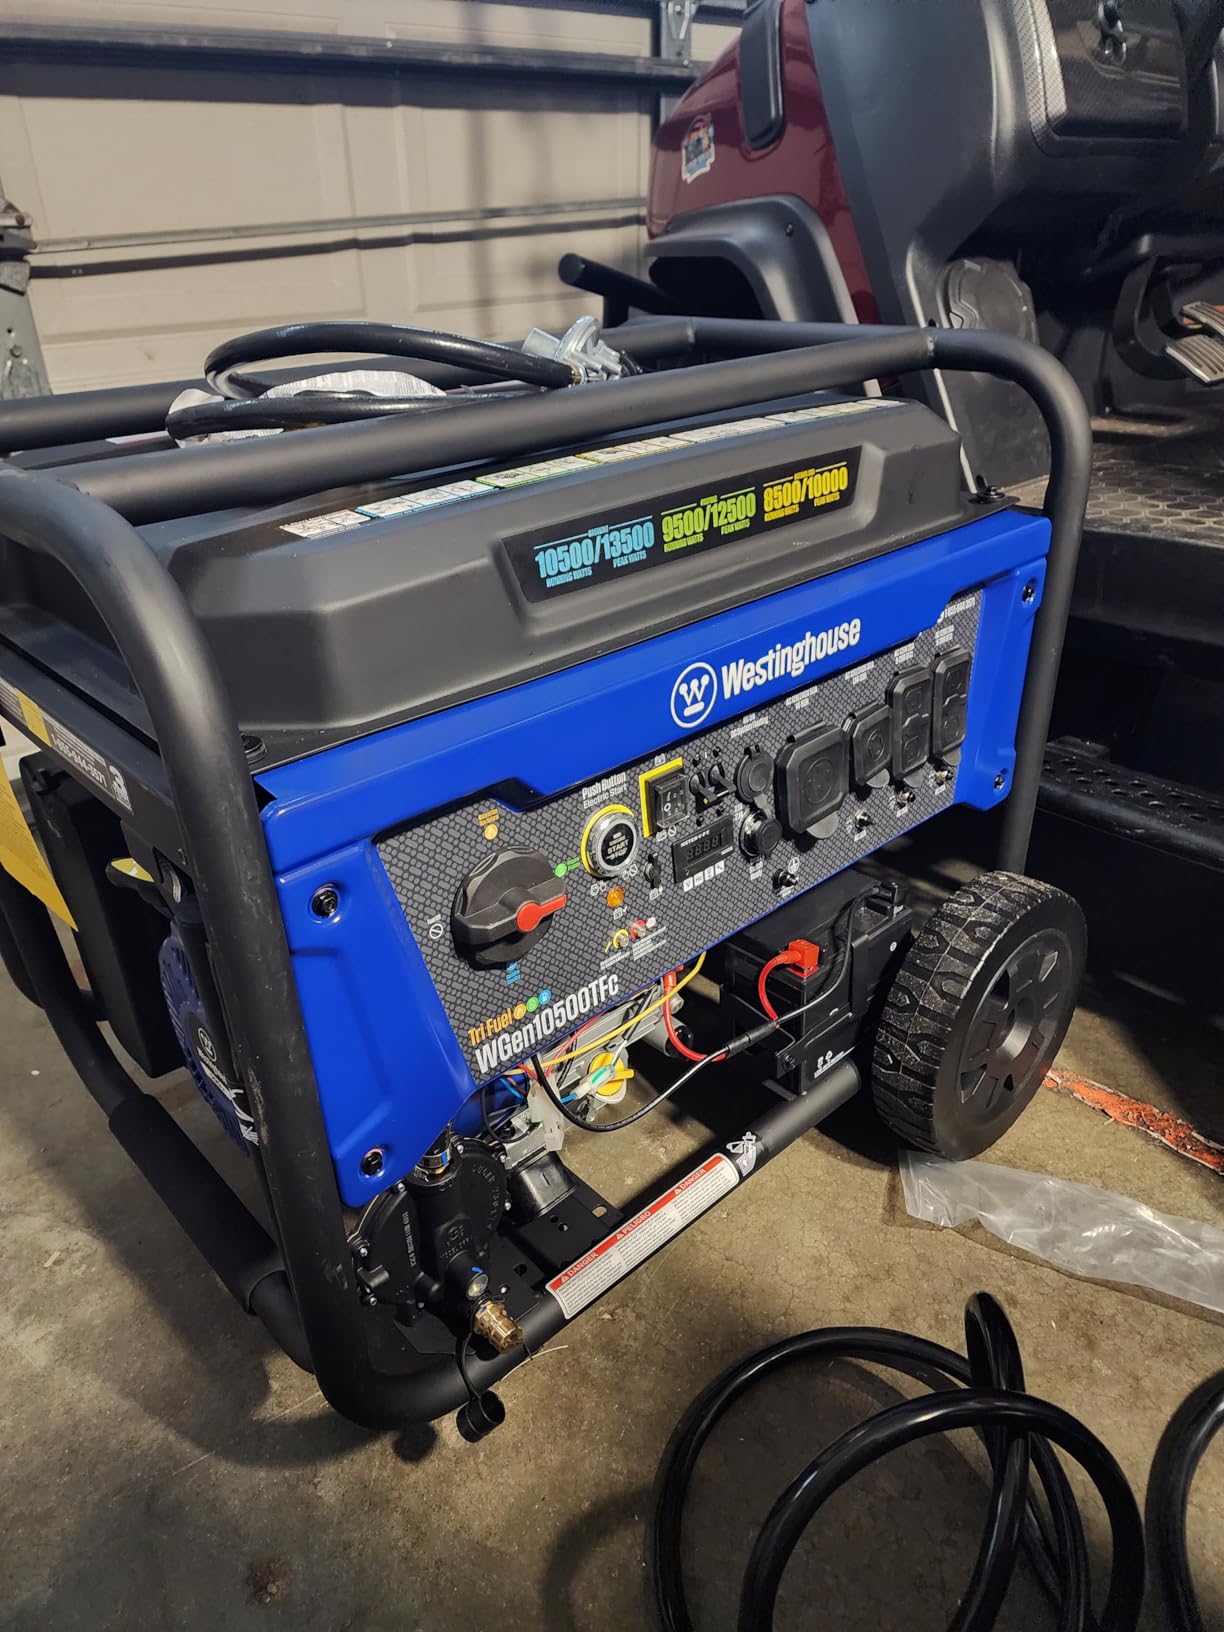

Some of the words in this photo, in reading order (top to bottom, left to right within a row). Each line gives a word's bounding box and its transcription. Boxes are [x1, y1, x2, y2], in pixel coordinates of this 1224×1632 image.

[661, 492, 756, 543] 9500/12500
[534, 521, 655, 579] 10500/13500
[721, 618, 862, 700] Westinghouse
[582, 782, 602, 800] Push
[601, 771, 627, 792] Button
[583, 792, 610, 810] Electric
[609, 783, 628, 798] Start
[607, 839, 629, 855] START
[468, 1023, 486, 1047] Tri
[485, 1007, 513, 1037] Fuel
[680, 1167, 707, 1191] DANGER
[622, 1210, 652, 1235] PELIGRO
[567, 1252, 599, 1278] DANGER
